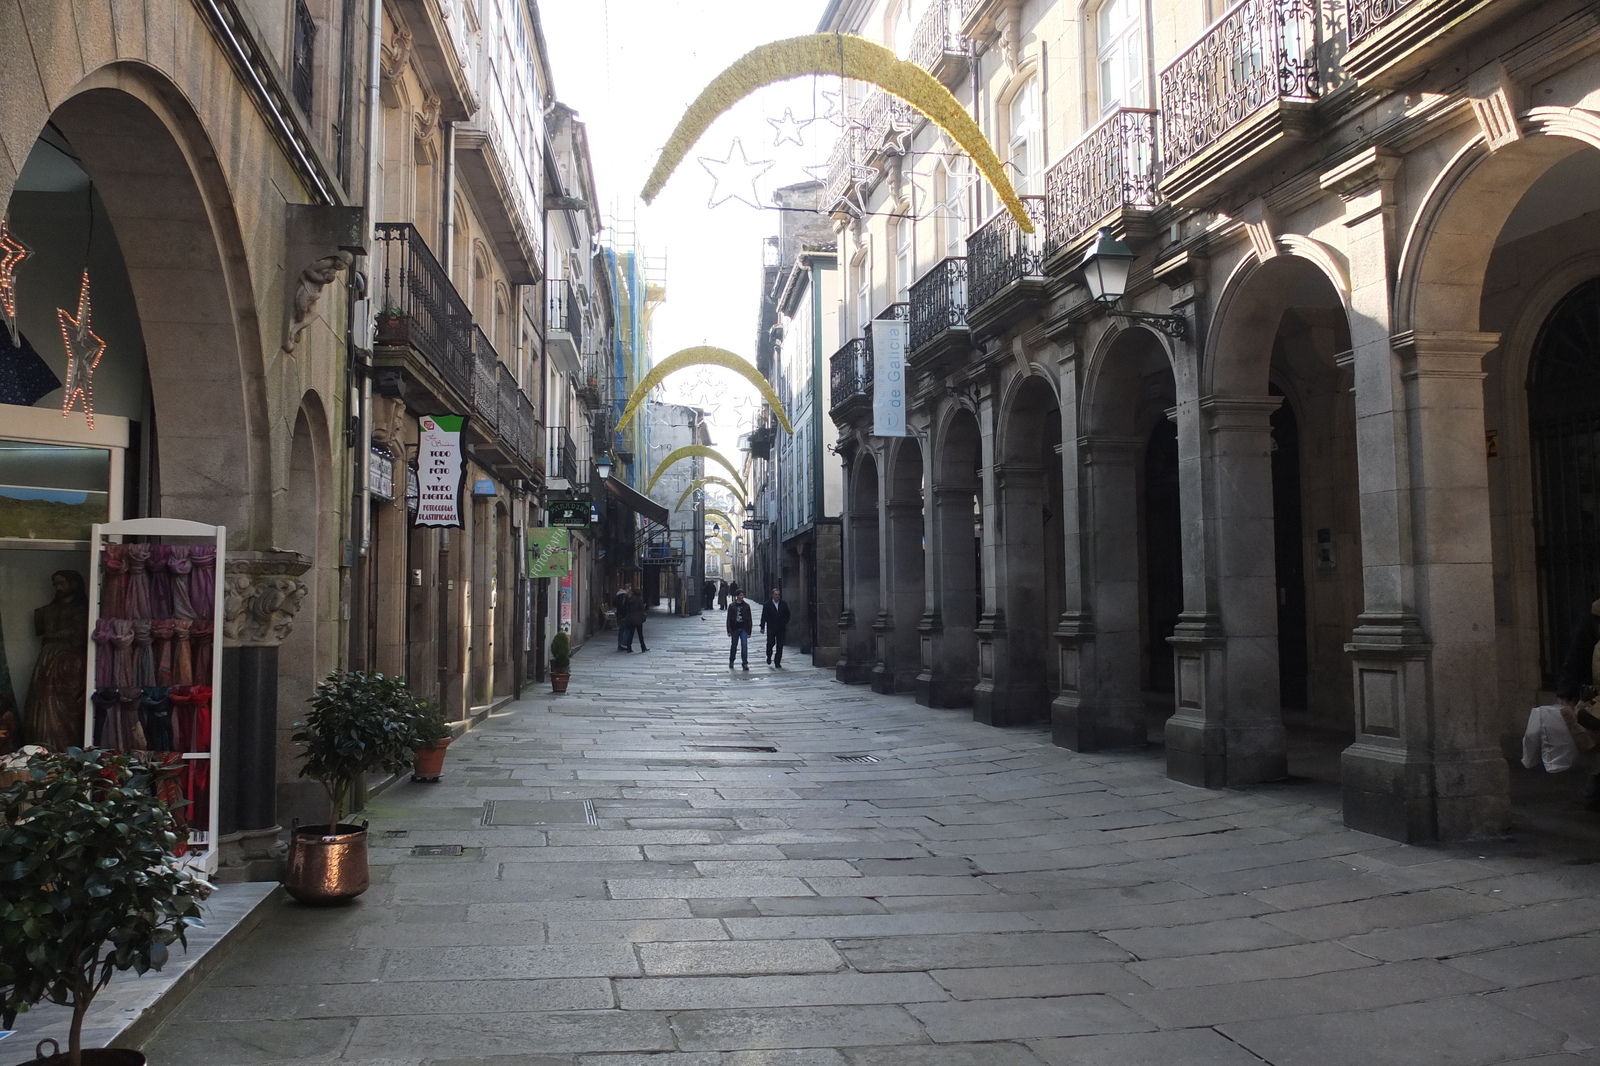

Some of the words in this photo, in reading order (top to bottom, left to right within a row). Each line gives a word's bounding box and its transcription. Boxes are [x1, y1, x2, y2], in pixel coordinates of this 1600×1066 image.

[887, 328, 901, 382] Galicia
[888, 389, 901, 408] de
[530, 527, 567, 577] FOTOGRAFIA
